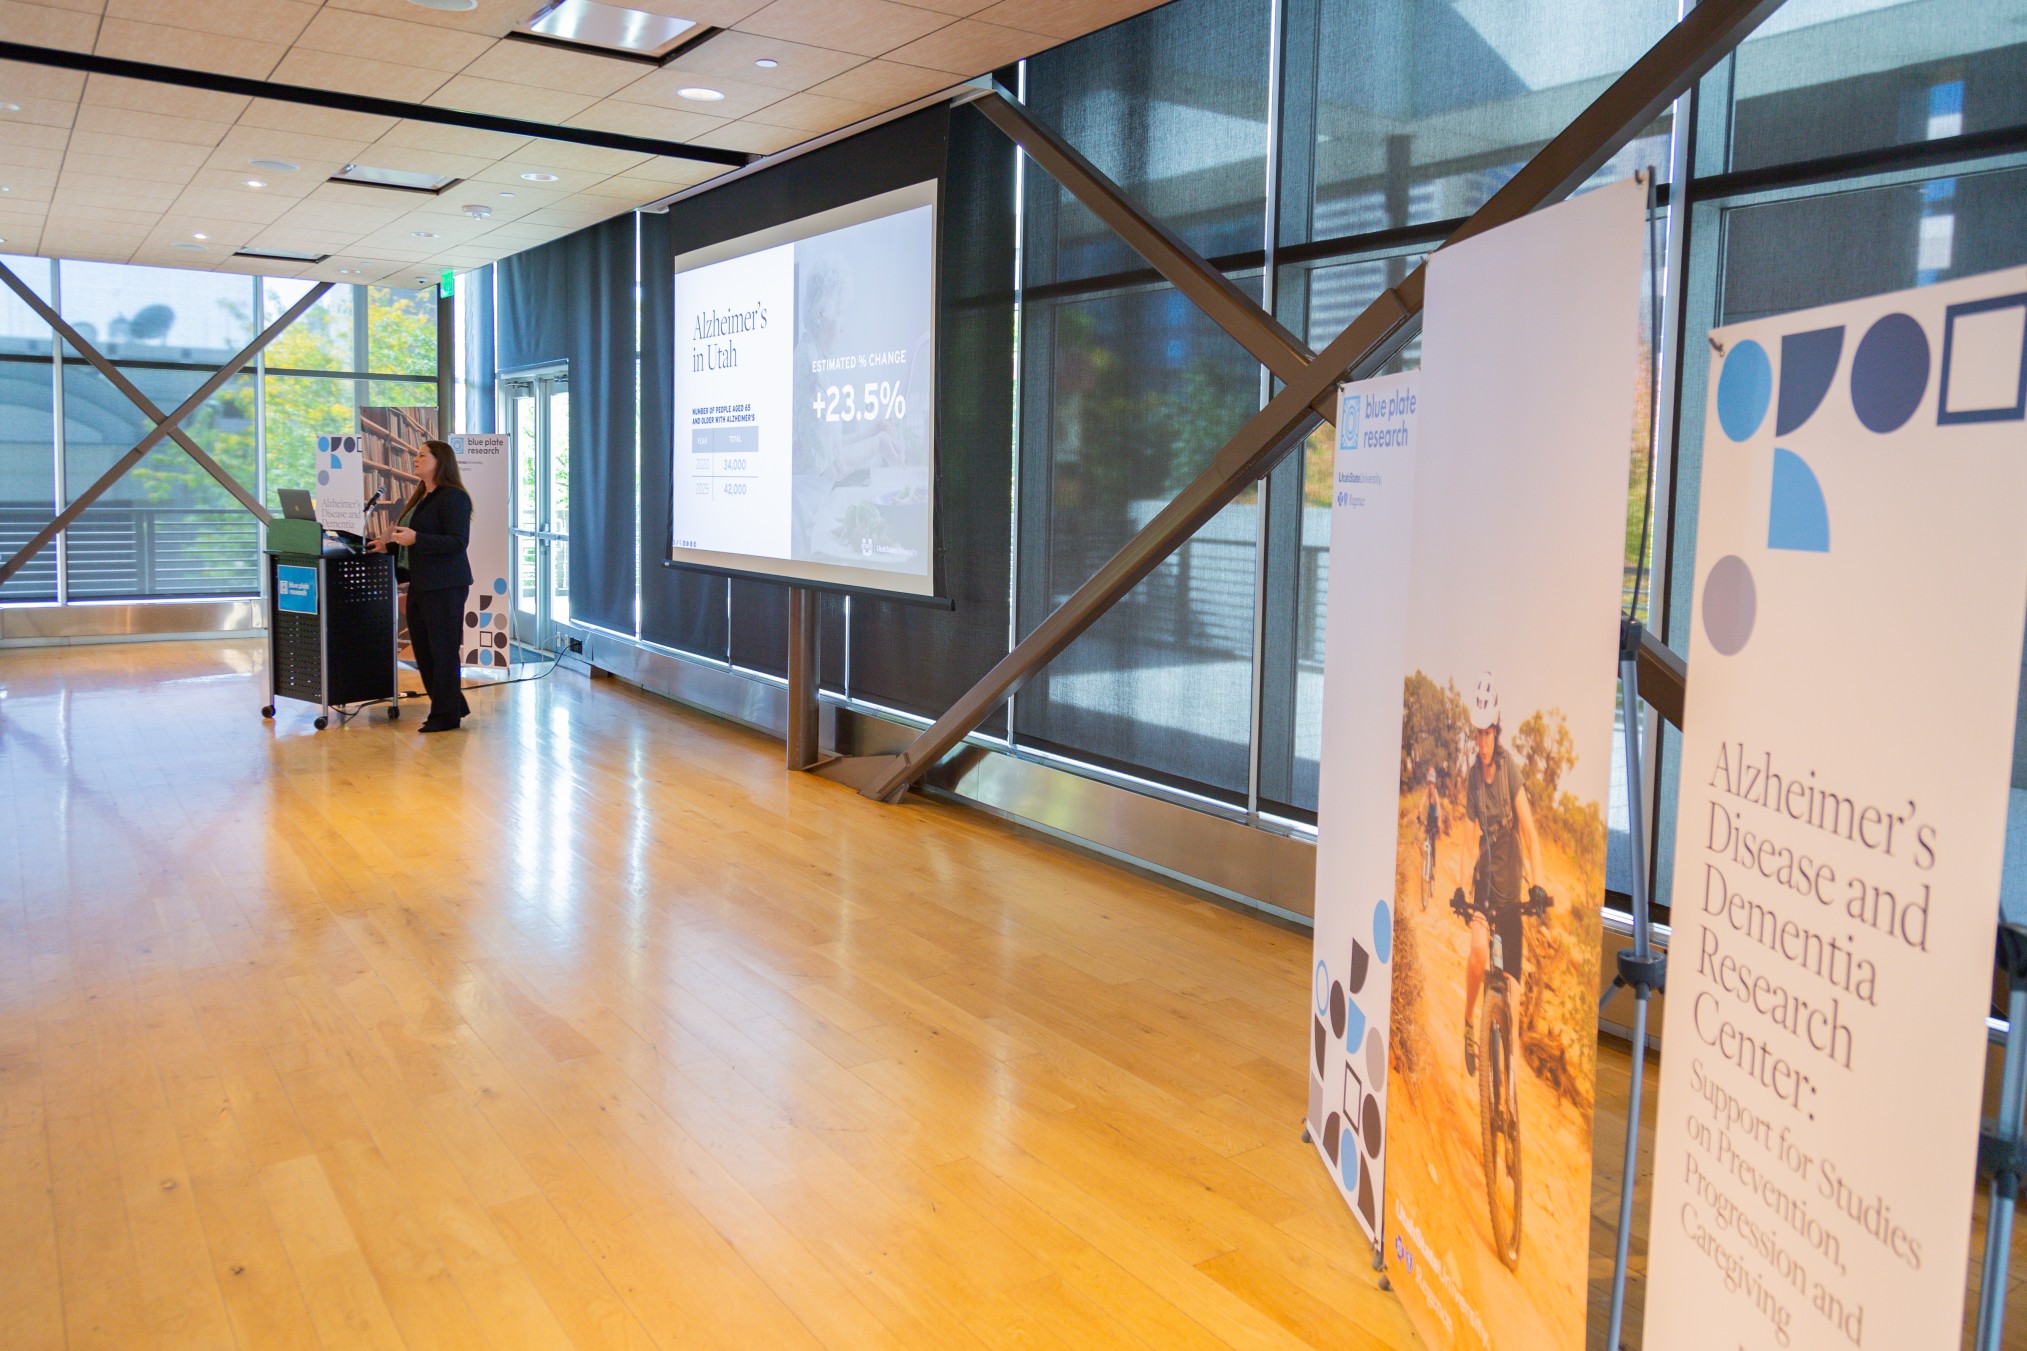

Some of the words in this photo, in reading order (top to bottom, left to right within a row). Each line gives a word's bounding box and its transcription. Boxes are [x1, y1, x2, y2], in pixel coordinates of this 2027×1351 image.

[693, 301, 767, 340] Alzheimer's
[693, 347, 704, 372] in
[707, 340, 738, 371] Utah
[812, 355, 856, 373] ESTIMATED
[858, 354, 867, 367] %
[869, 350, 906, 367] CHANGE
[692, 407, 709, 415] NUMBER
[709, 406, 715, 414] OF
[716, 405, 731, 414] PEOPLE
[733, 404, 744, 412] AGED
[692, 417, 701, 425] AND
[701, 416, 715, 424] OLDER
[715, 415, 726, 423] WITH
[726, 413, 756, 423] ALZHEIMER'S
[812, 380, 906, 422] +23.5%
[1365, 393, 1386, 419] blue
[1388, 387, 1417, 421] plate
[467, 438, 484, 446] blue
[485, 437, 504, 447] plate
[467, 447, 500, 455] research
[1364, 420, 1408, 448] research
[723, 458, 747, 471] 34,000
[723, 483, 747, 496] 42,000
[1708, 741, 1937, 871] Alzheimer's
[1704, 800, 1836, 906] Disease
[1846, 883, 1930, 953] and
[1701, 862, 1878, 1007] Dementia
[1696, 923, 1854, 1072] Research
[1694, 991, 1818, 1121] Center:
[1690, 1058, 1774, 1151] Support
[1778, 1126, 1813, 1180] for
[1818, 1158, 1923, 1272] Studies
[1687, 1115, 1711, 1152] on
[1716, 1129, 1847, 1277] Prevention,
[1683, 1151, 1807, 1297] Progression
[1812, 1282, 1864, 1349] and
[1681, 1202, 1792, 1349] Caregiving
